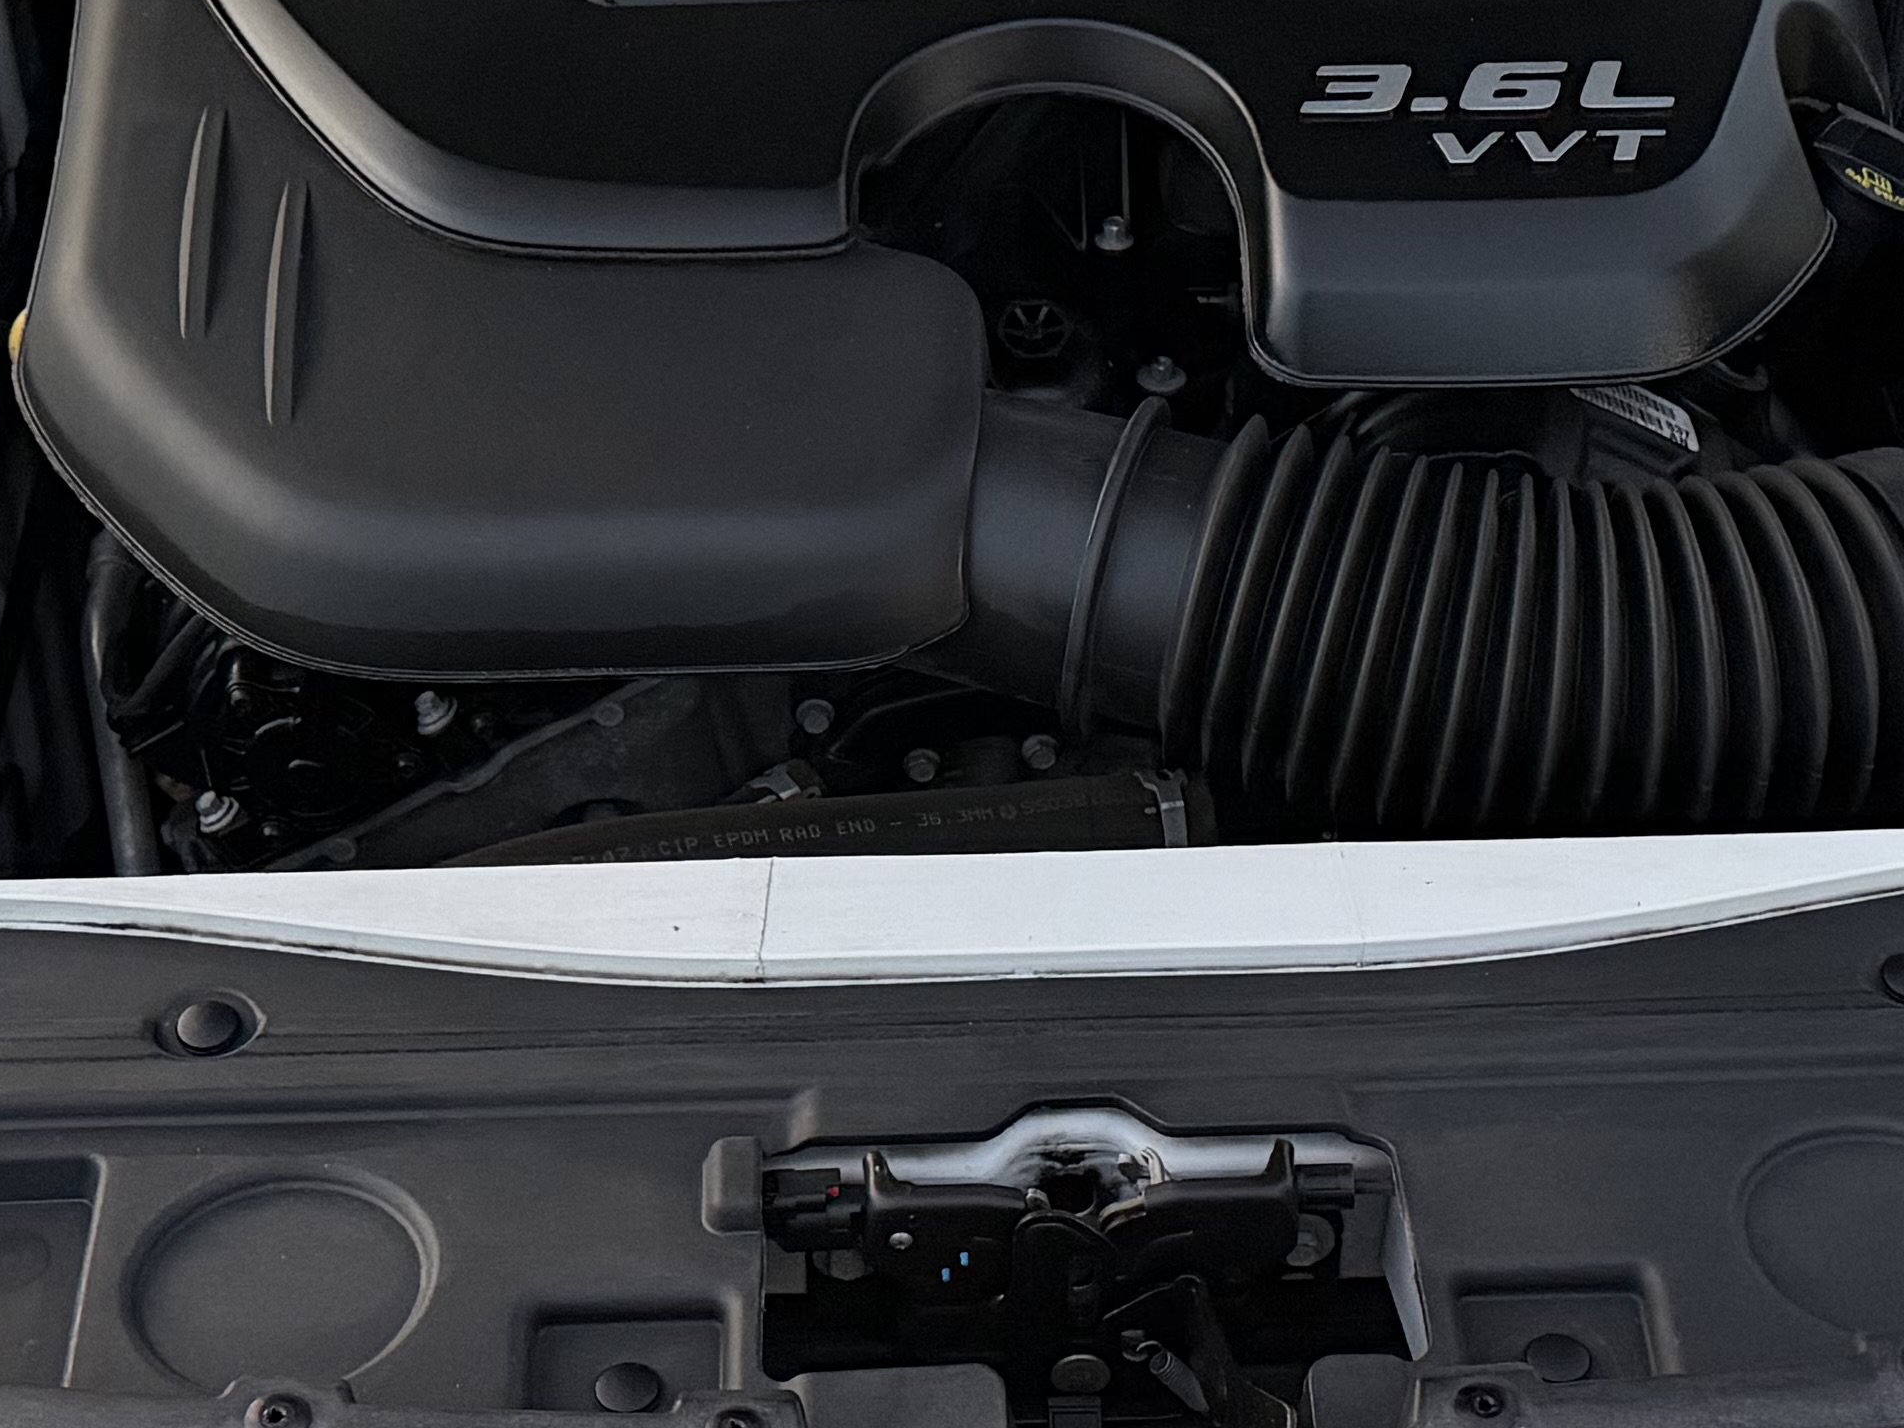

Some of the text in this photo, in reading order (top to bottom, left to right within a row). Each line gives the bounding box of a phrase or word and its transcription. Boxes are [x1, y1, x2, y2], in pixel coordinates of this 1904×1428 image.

[1299, 60, 1676, 115] 3.6L
[1432, 128, 1667, 165] VVT
[712, 828, 770, 849] EPDM
[778, 823, 821, 843] RAD
[834, 817, 876, 837] END
